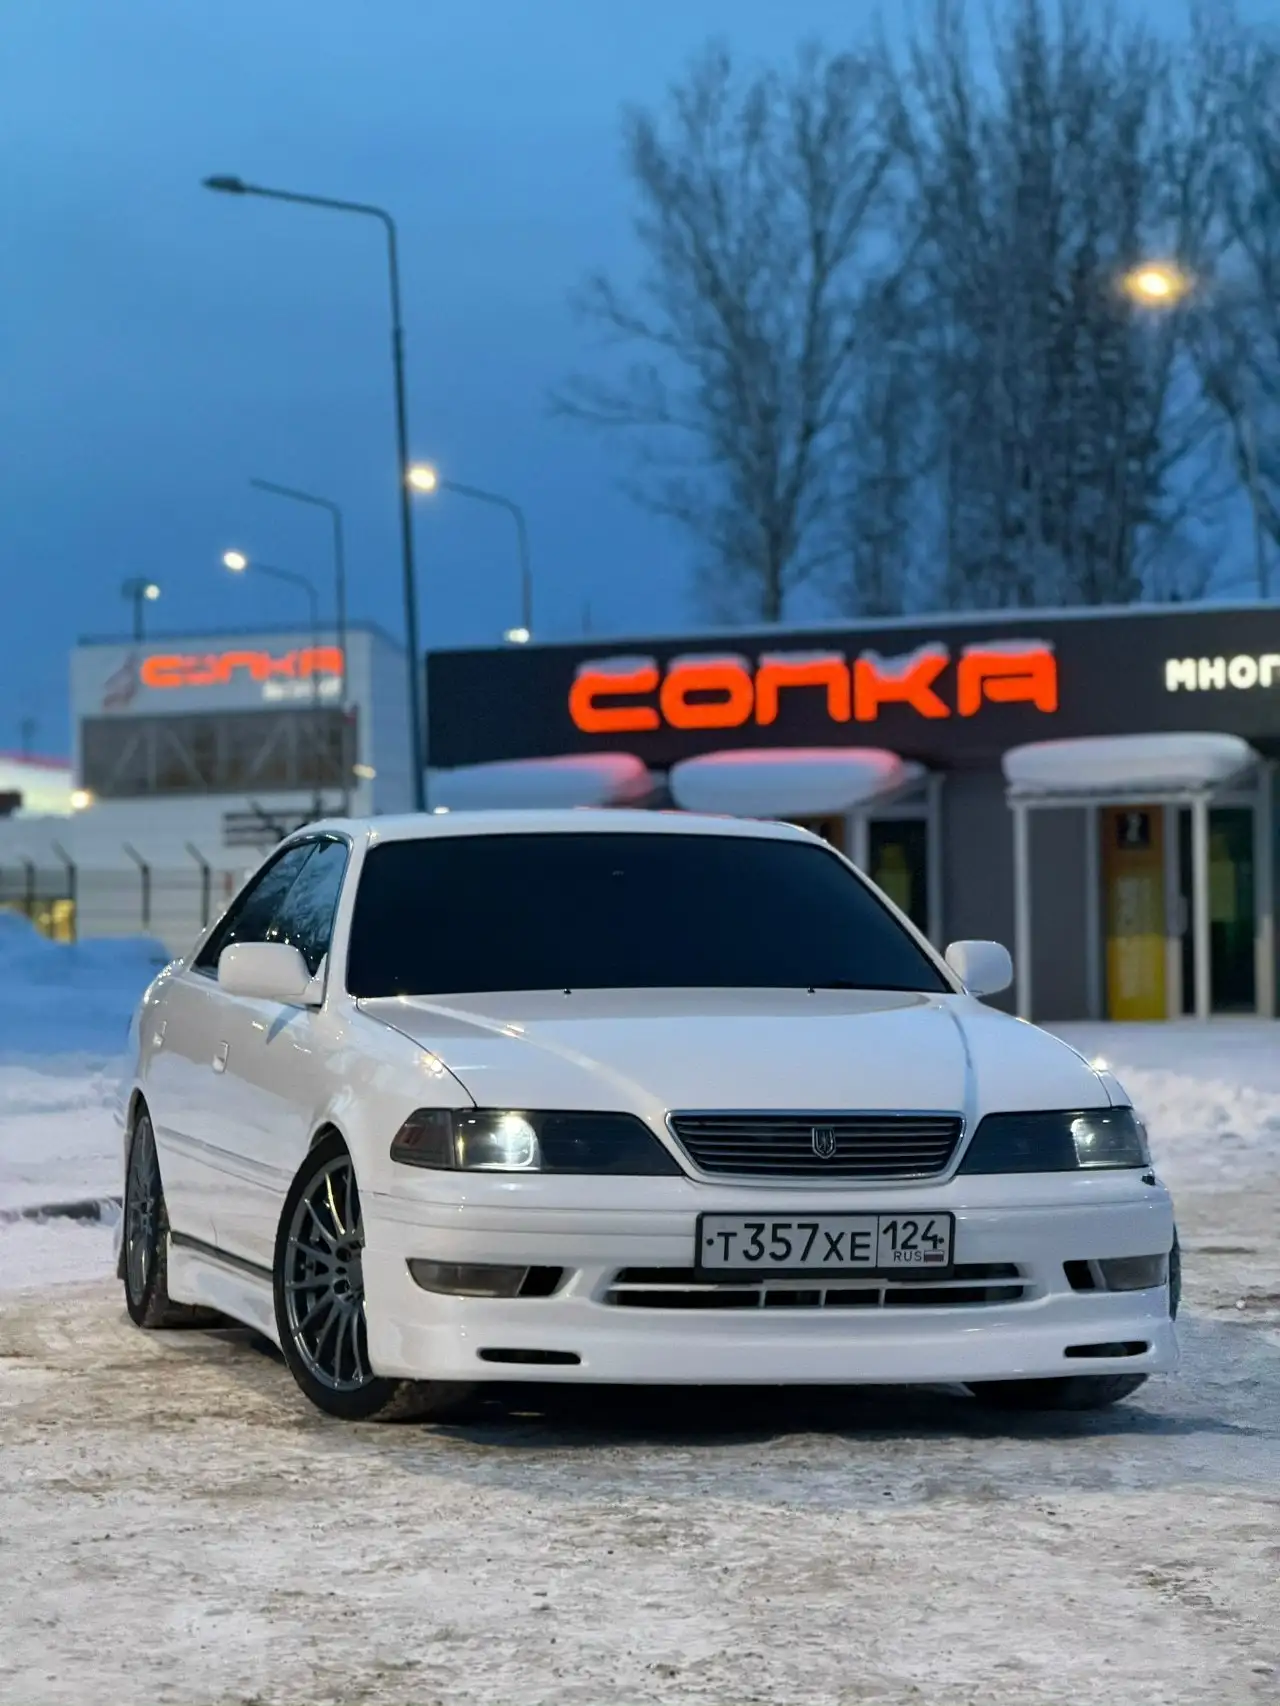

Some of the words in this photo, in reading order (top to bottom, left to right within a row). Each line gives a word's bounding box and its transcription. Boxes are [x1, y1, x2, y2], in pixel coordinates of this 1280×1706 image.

[569, 641, 1058, 733] СОПКА
[717, 1223, 871, 1262] Т357ХЕ
[882, 1220, 938, 1250] 124
[893, 1251, 922, 1262] RUS
